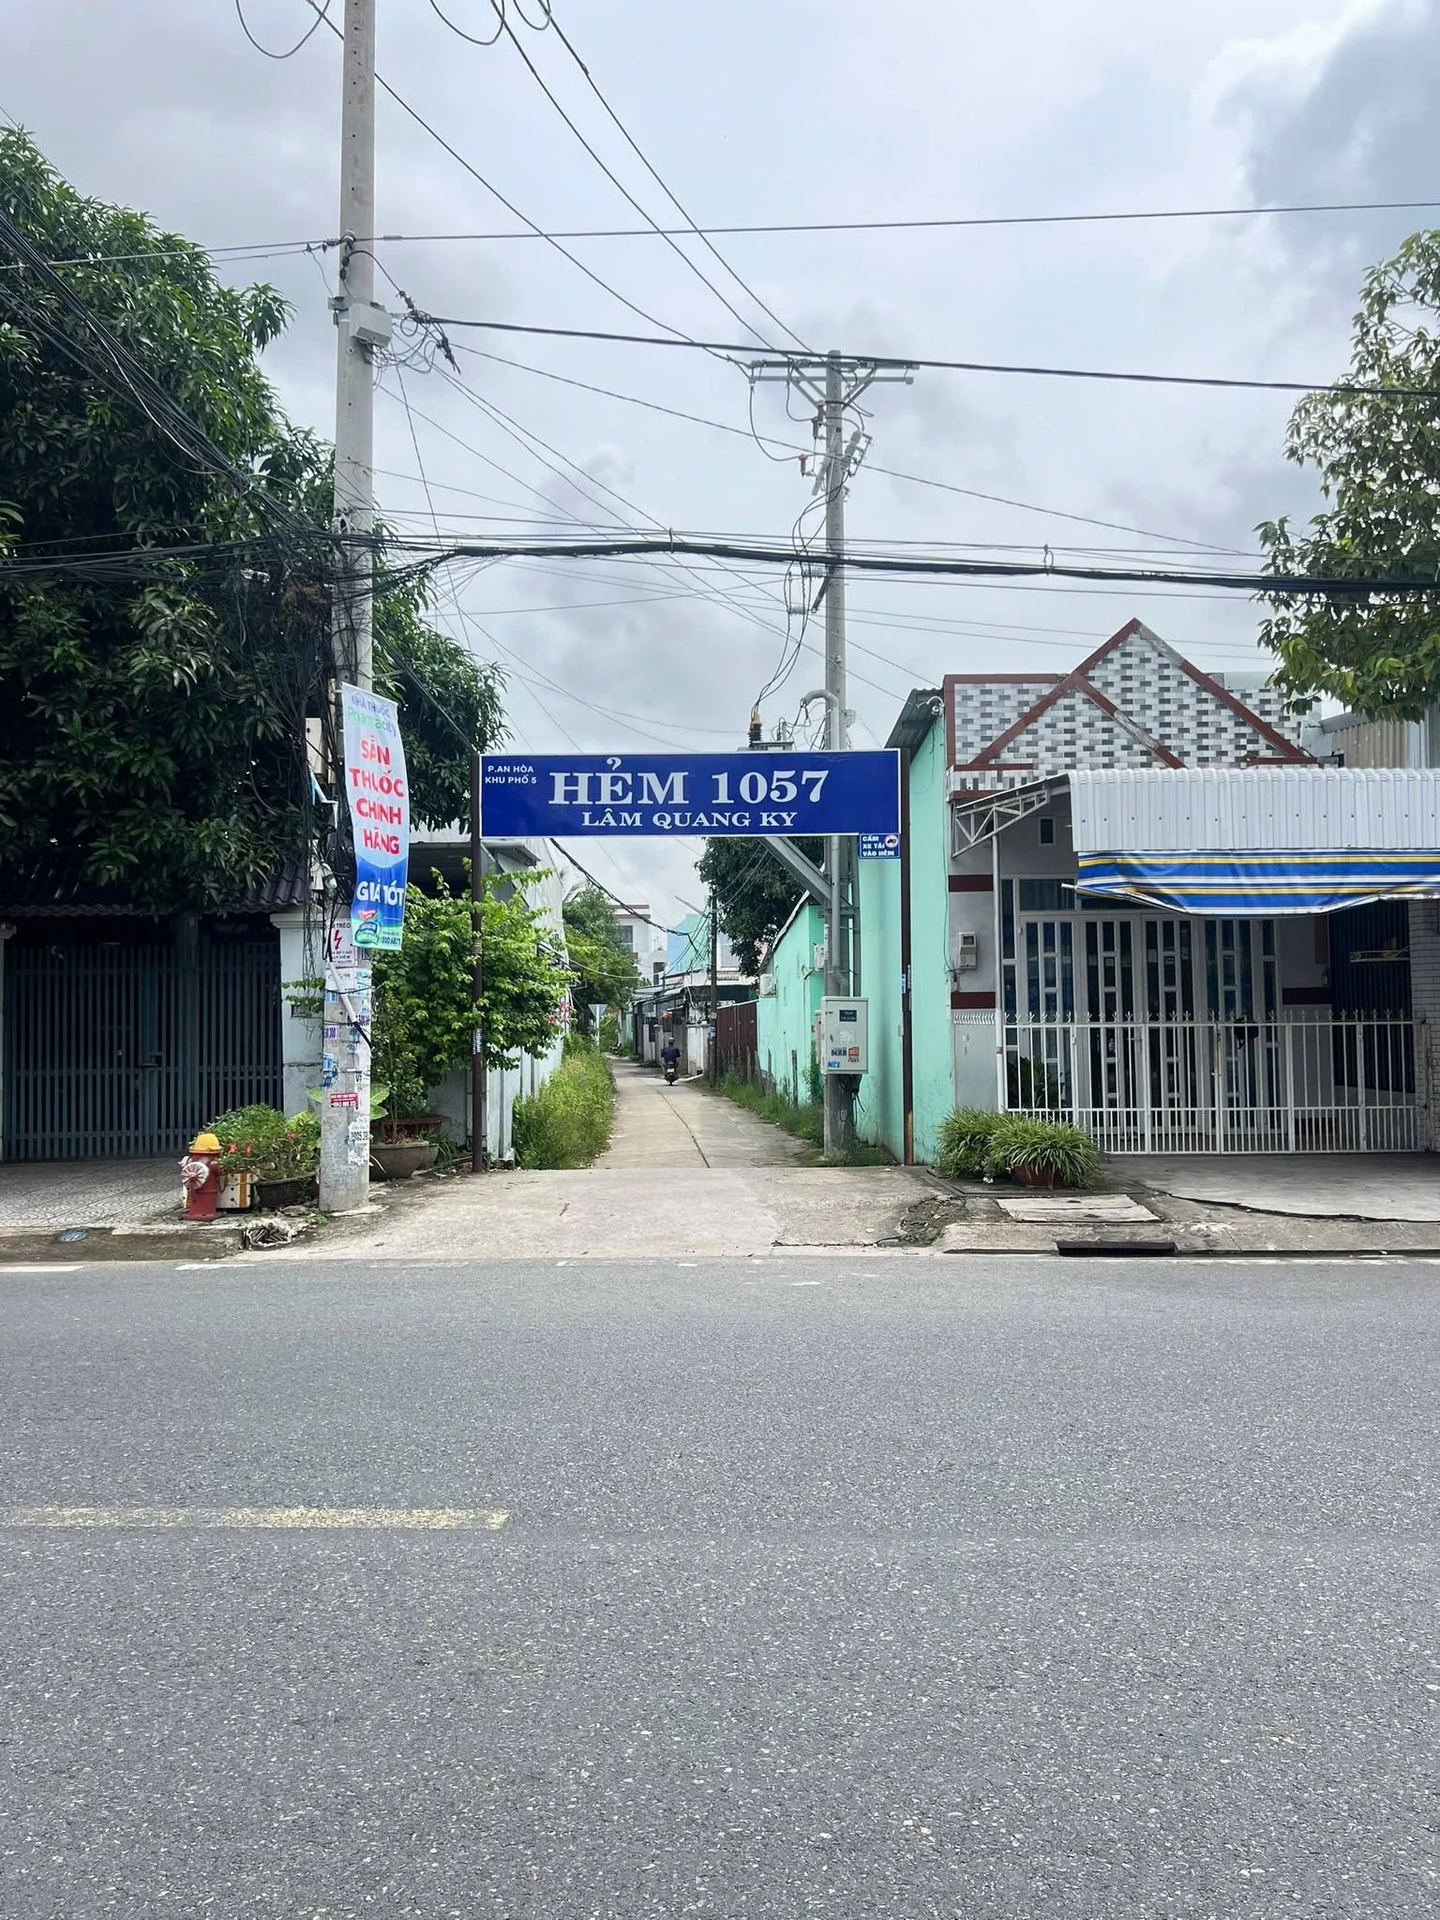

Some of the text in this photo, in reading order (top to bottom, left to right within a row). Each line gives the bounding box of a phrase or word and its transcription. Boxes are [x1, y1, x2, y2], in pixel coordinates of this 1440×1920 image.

[361, 734, 390, 766] SẴN
[485, 774, 537, 784] KHU PHỐ 5
[488, 764, 534, 773] P.AN HÒA
[548, 757, 829, 806] HẺM 1057
[349, 769, 405, 798] THUỐC
[356, 797, 402, 825] CHÍNH
[581, 809, 798, 830] LÂM QUANG KY
[363, 827, 400, 855] HÃNG
[356, 878, 381, 903] GIÁ
